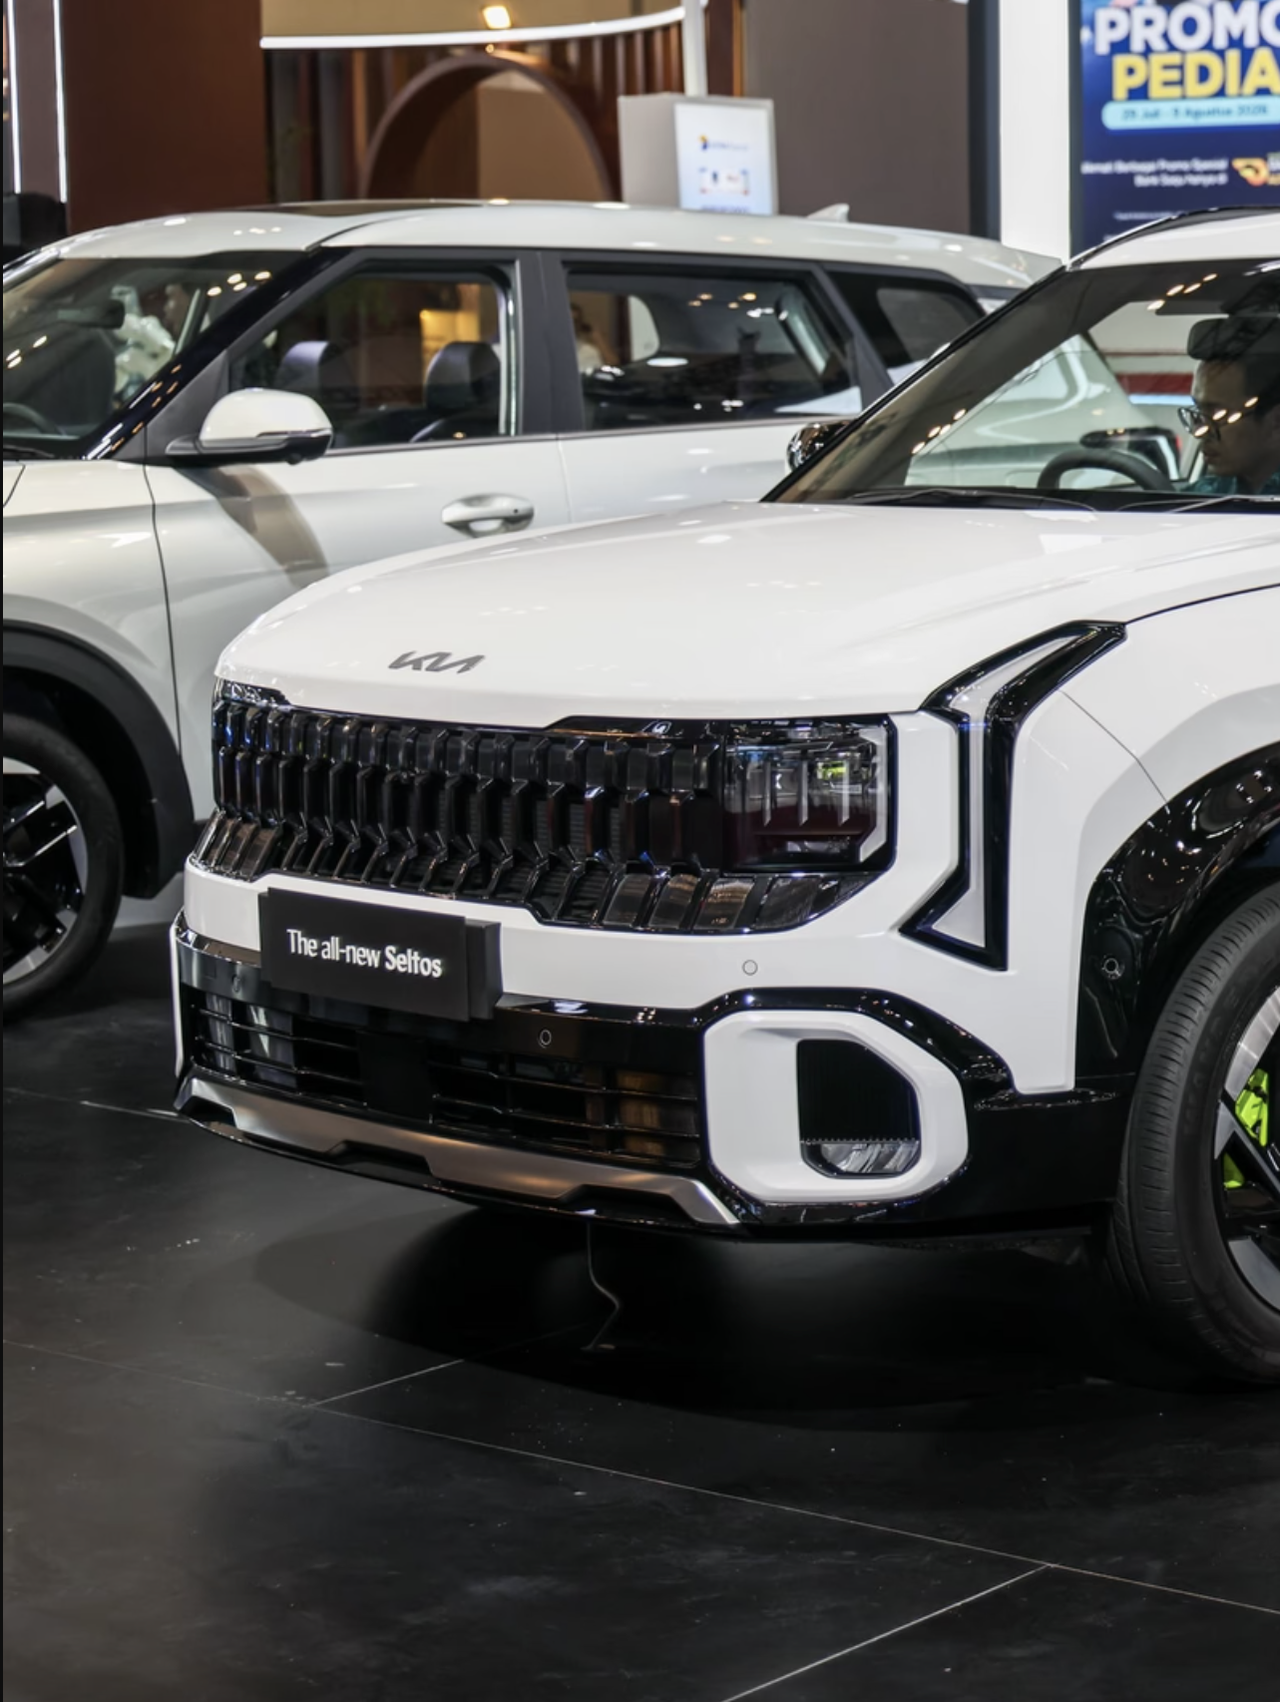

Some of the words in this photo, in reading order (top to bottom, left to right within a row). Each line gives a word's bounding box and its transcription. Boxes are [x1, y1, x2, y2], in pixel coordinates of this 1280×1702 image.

[388, 650, 485, 674] KIA
[286, 928, 318, 957] The
[321, 936, 381, 968] all-new
[384, 945, 444, 978] Seltos
